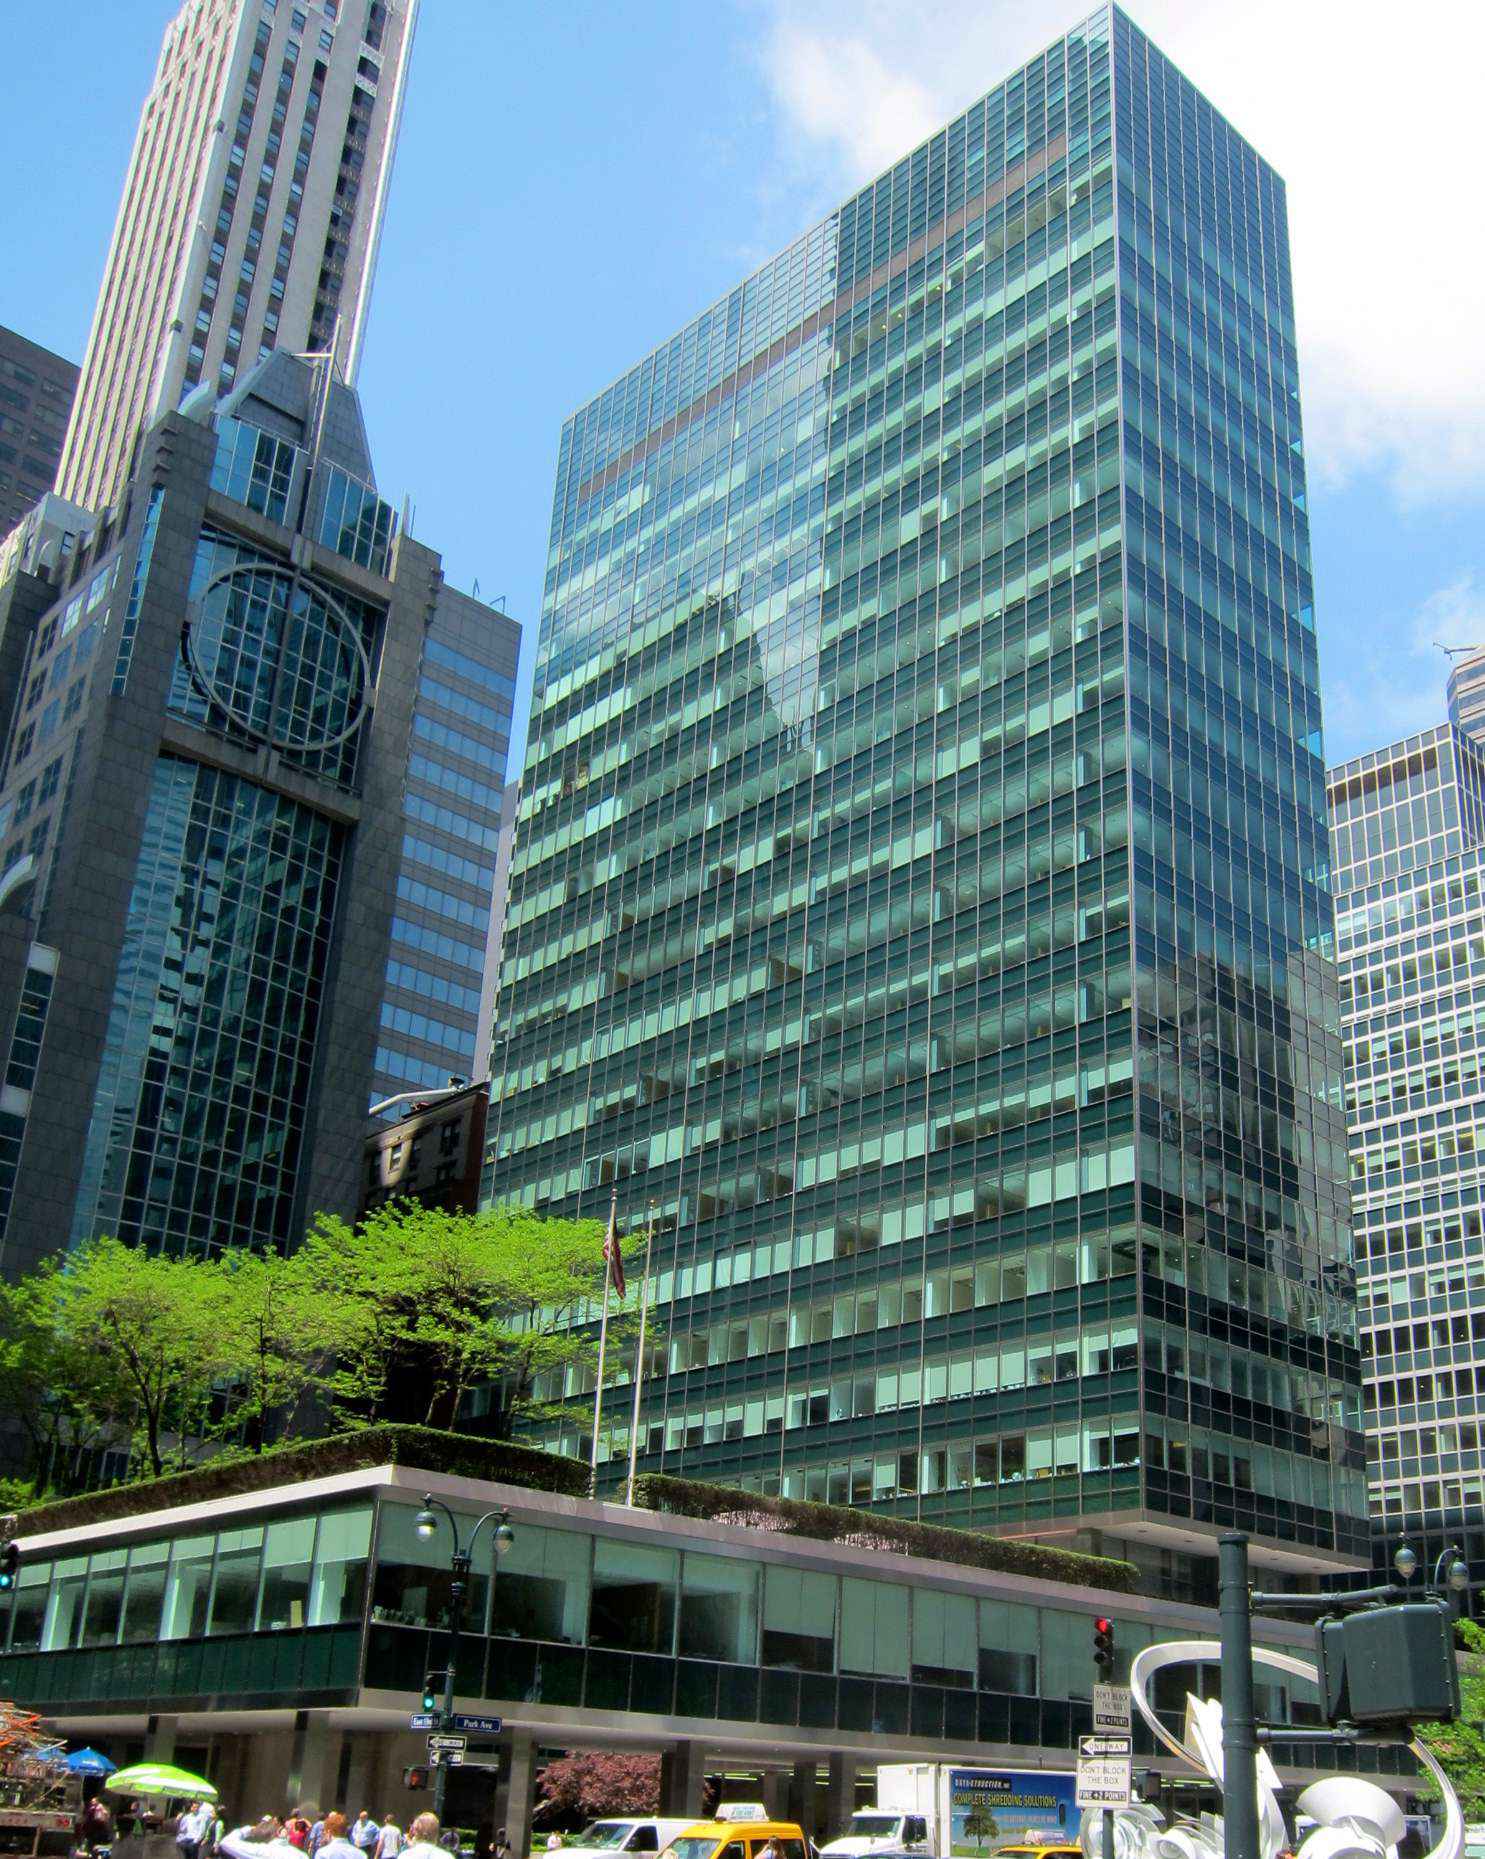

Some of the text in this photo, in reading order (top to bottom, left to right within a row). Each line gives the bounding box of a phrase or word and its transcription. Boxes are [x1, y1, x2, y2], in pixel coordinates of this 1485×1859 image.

[463, 1718, 493, 1730] Park Ave
[1108, 1743, 1124, 1752] WAY
[1103, 1766, 1126, 1775] BLOCK
[1088, 1776, 1120, 1784] THE BOX
[953, 1792, 1057, 1808] COMPLETE SHREDDING SOLUTIONS
[1104, 1792, 1127, 1801] POINTS
